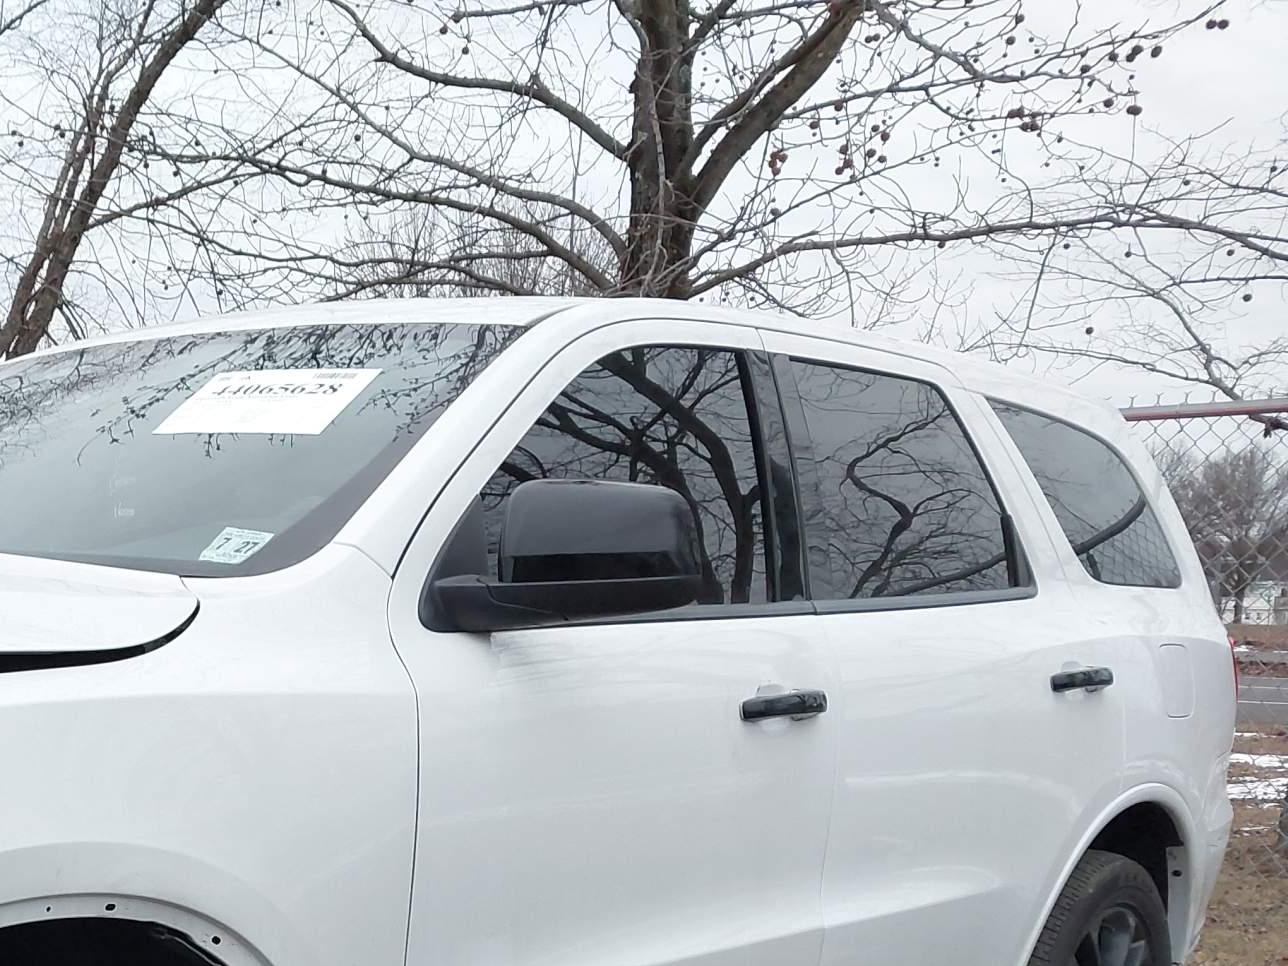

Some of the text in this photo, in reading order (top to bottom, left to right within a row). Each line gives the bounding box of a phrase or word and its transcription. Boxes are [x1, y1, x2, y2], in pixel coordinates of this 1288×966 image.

[212, 383, 344, 396] 44065628
[215, 537, 260, 554] 7 27
